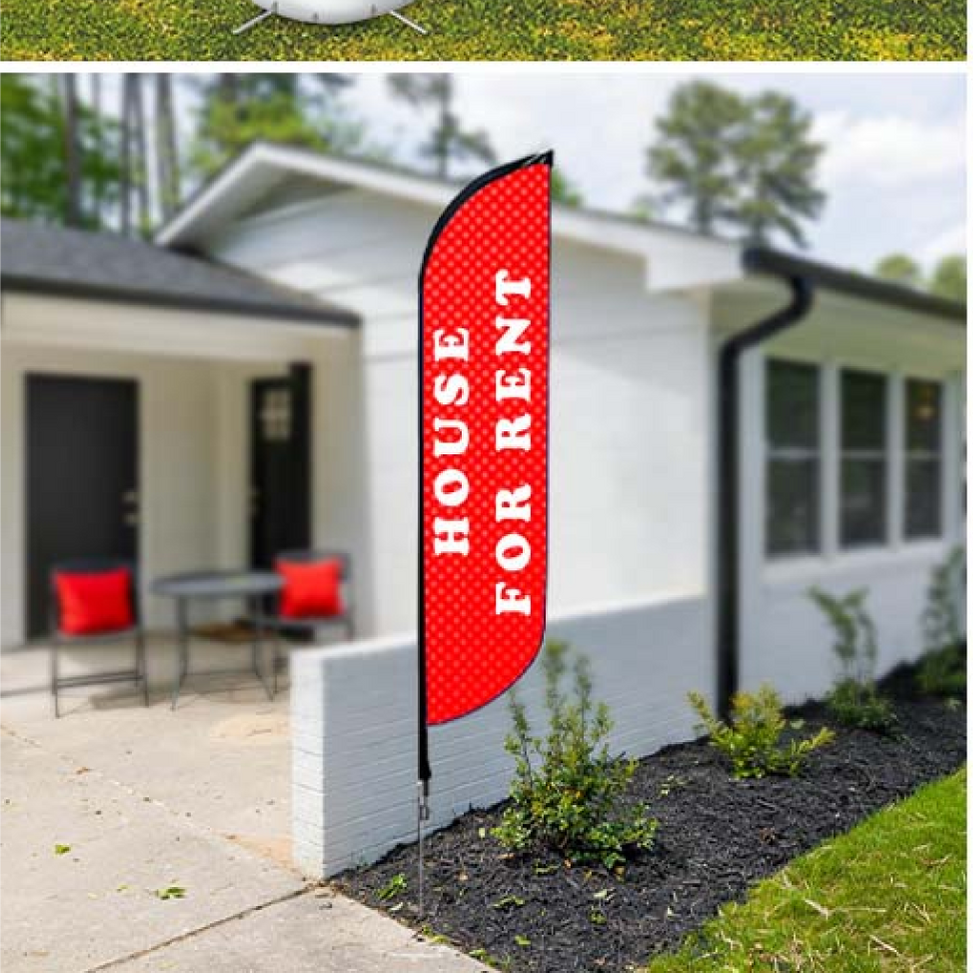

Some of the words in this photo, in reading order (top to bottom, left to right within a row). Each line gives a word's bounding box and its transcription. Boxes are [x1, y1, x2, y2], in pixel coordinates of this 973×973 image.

[432, 327, 470, 556] HOUSE
[495, 269, 532, 451] RENT
[495, 484, 532, 616] FOR
